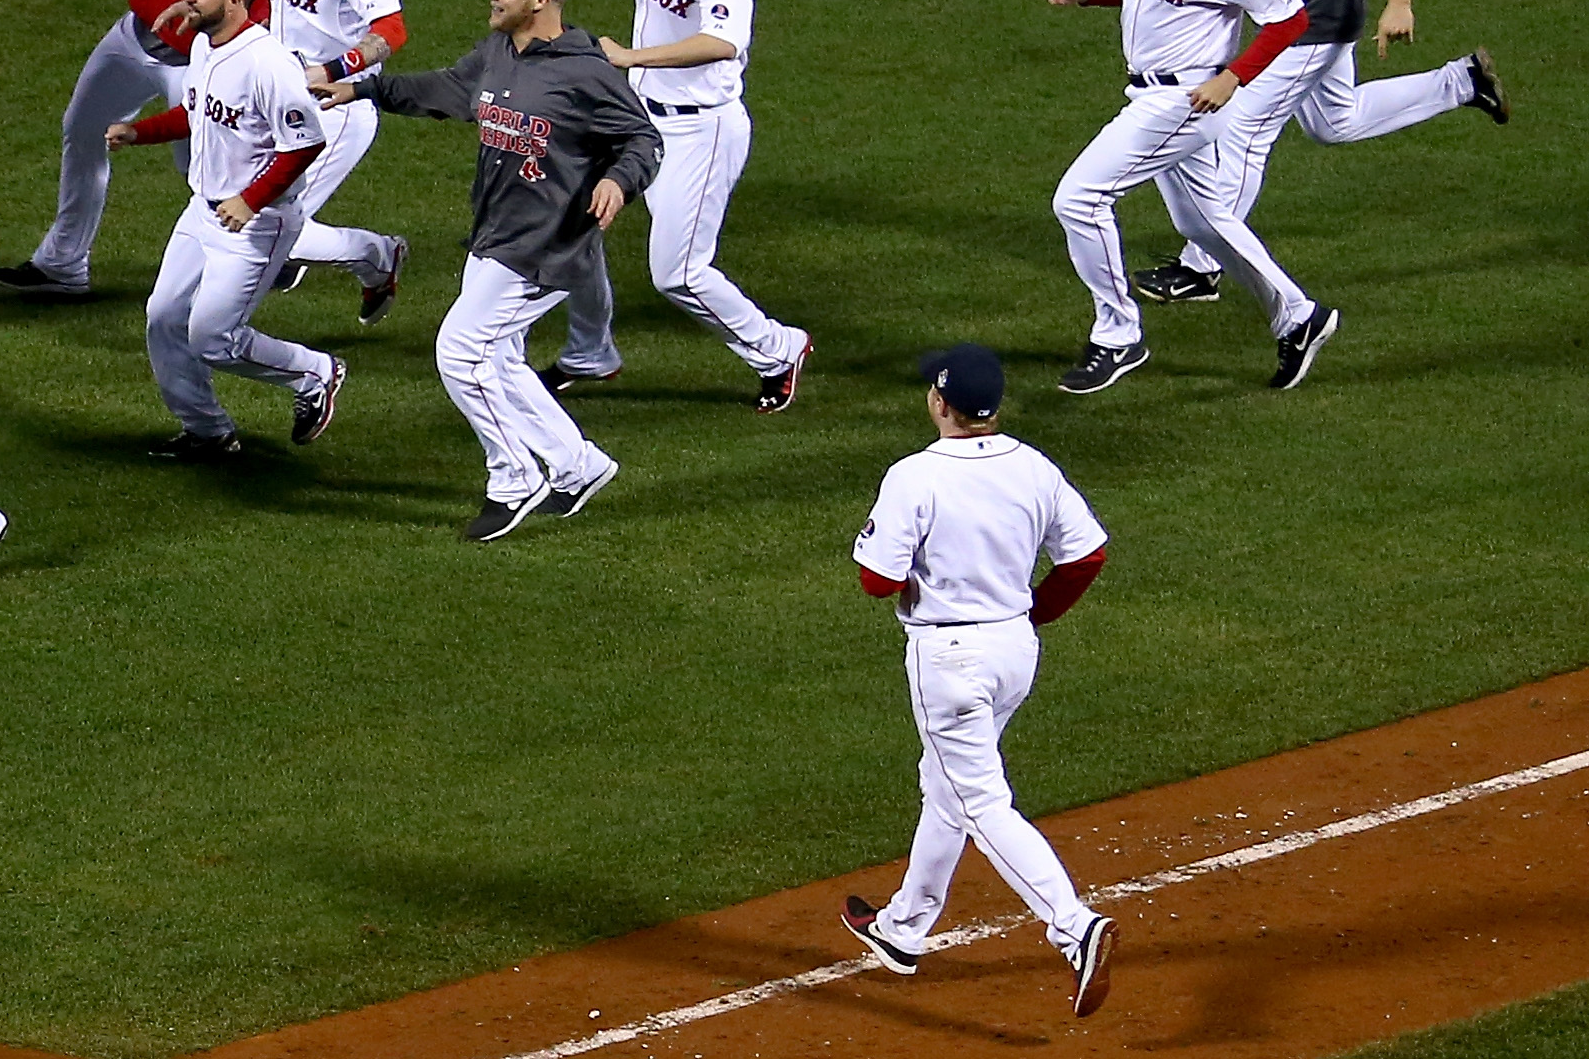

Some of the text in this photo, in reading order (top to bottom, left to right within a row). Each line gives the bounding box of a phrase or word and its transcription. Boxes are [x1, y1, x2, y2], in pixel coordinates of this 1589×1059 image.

[205, 94, 244, 131] SOX
[478, 101, 552, 138] WORLD
[480, 127, 548, 158] ERIES
